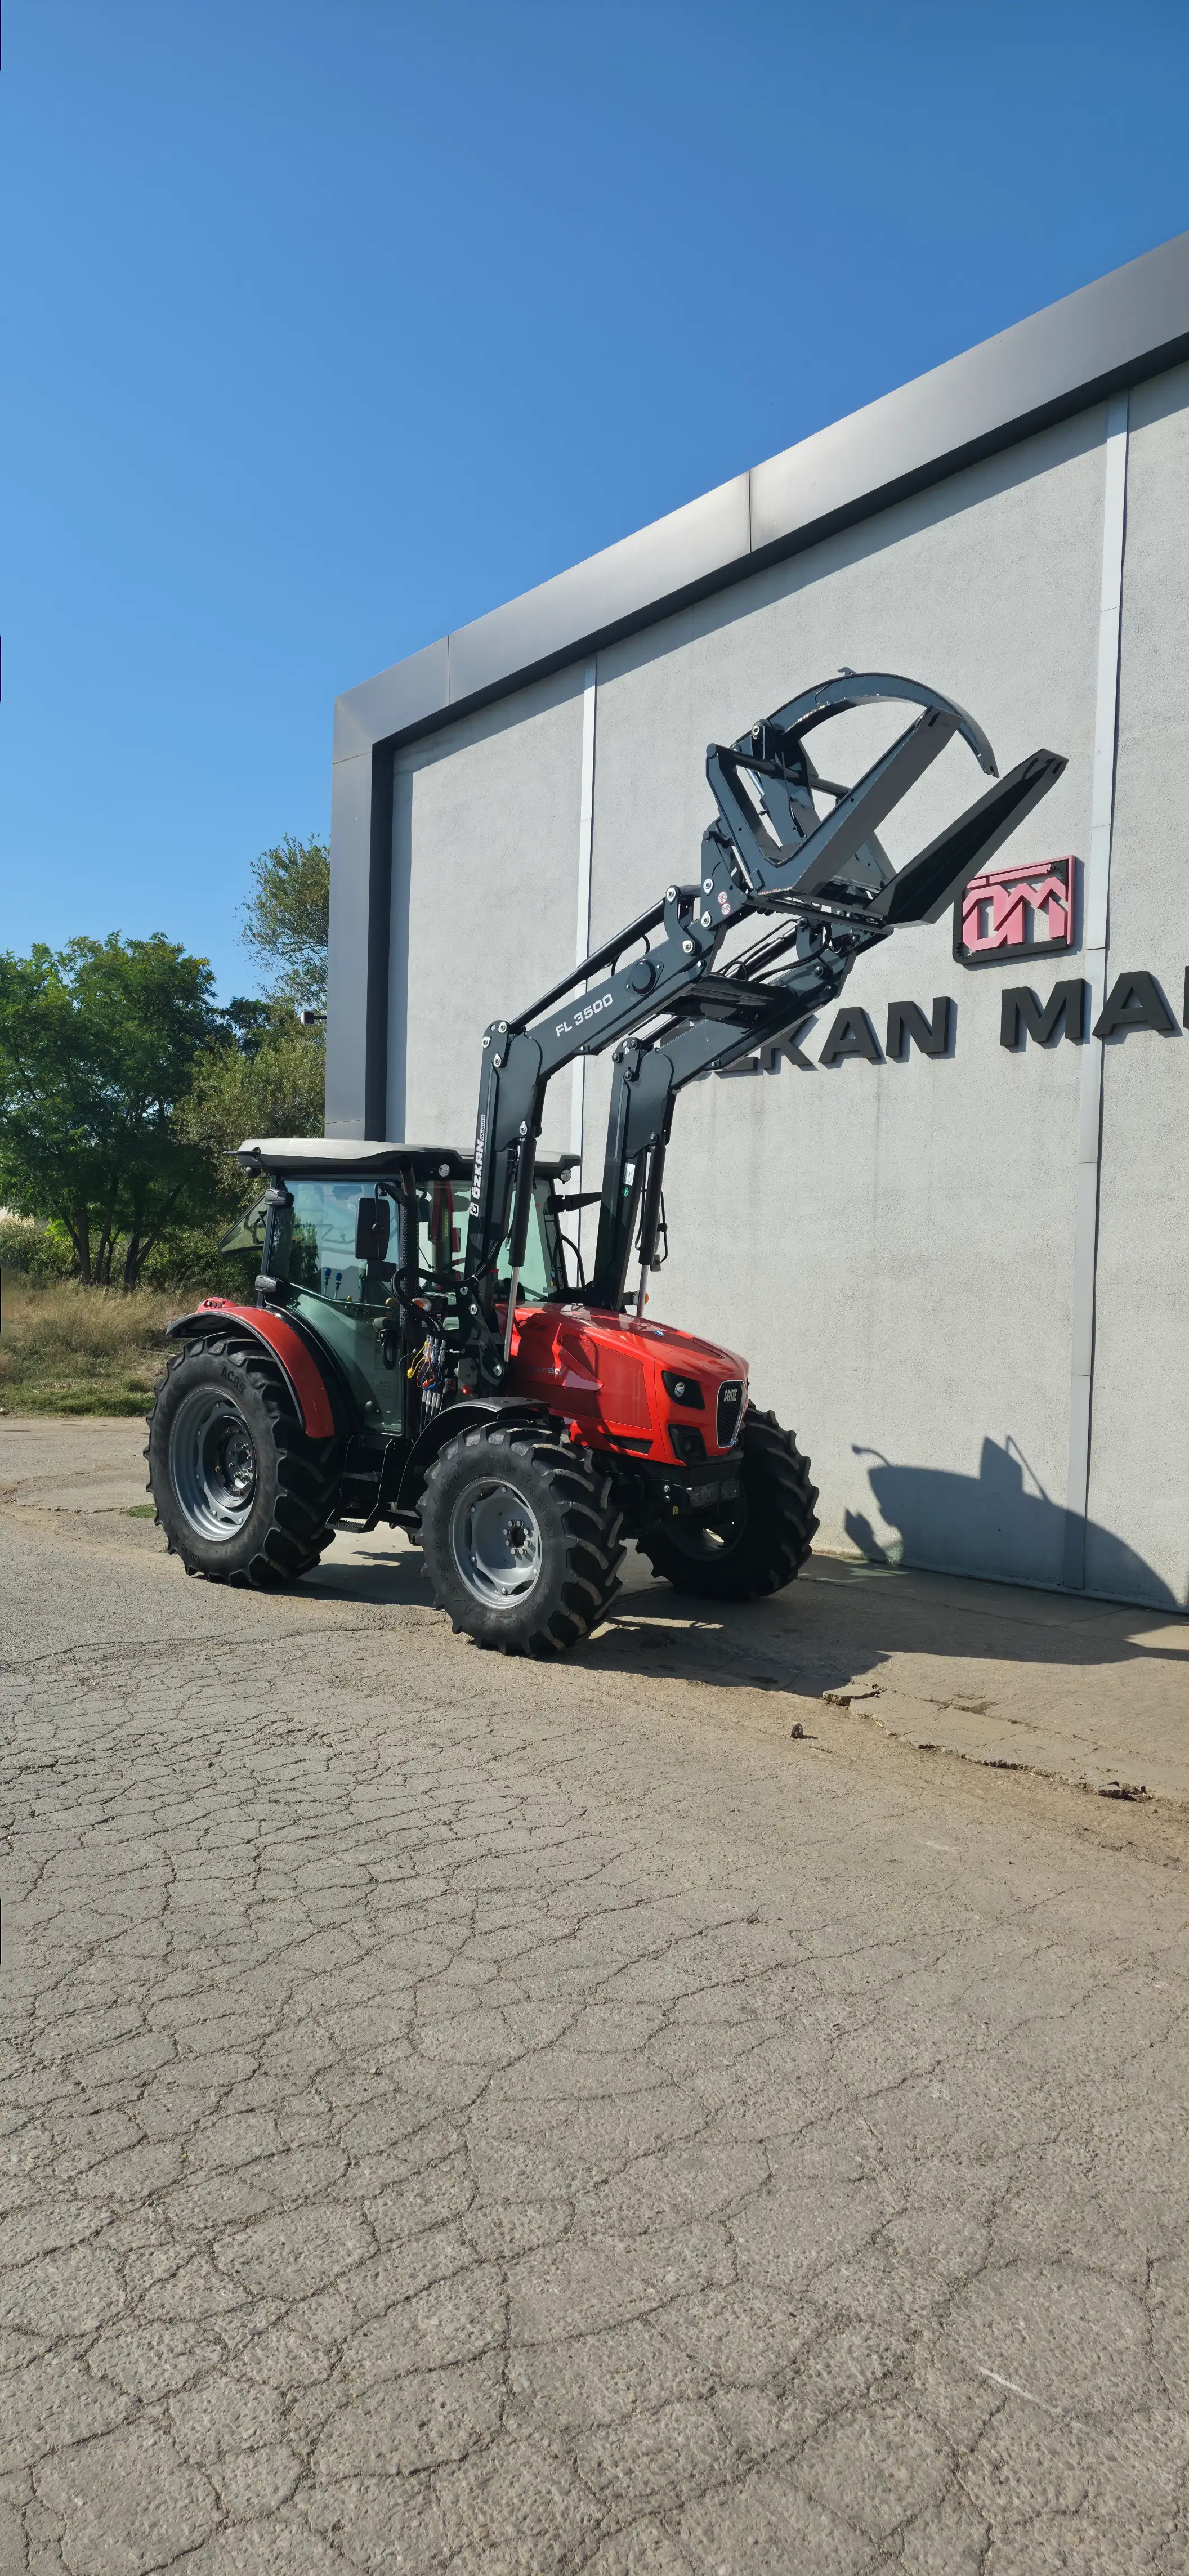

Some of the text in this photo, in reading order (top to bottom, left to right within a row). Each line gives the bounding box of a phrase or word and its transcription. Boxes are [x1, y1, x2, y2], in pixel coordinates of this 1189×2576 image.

[556, 993, 613, 1037] FL 3500
[1000, 966, 1189, 1046] MA
[723, 1388, 737, 1402] SAME
